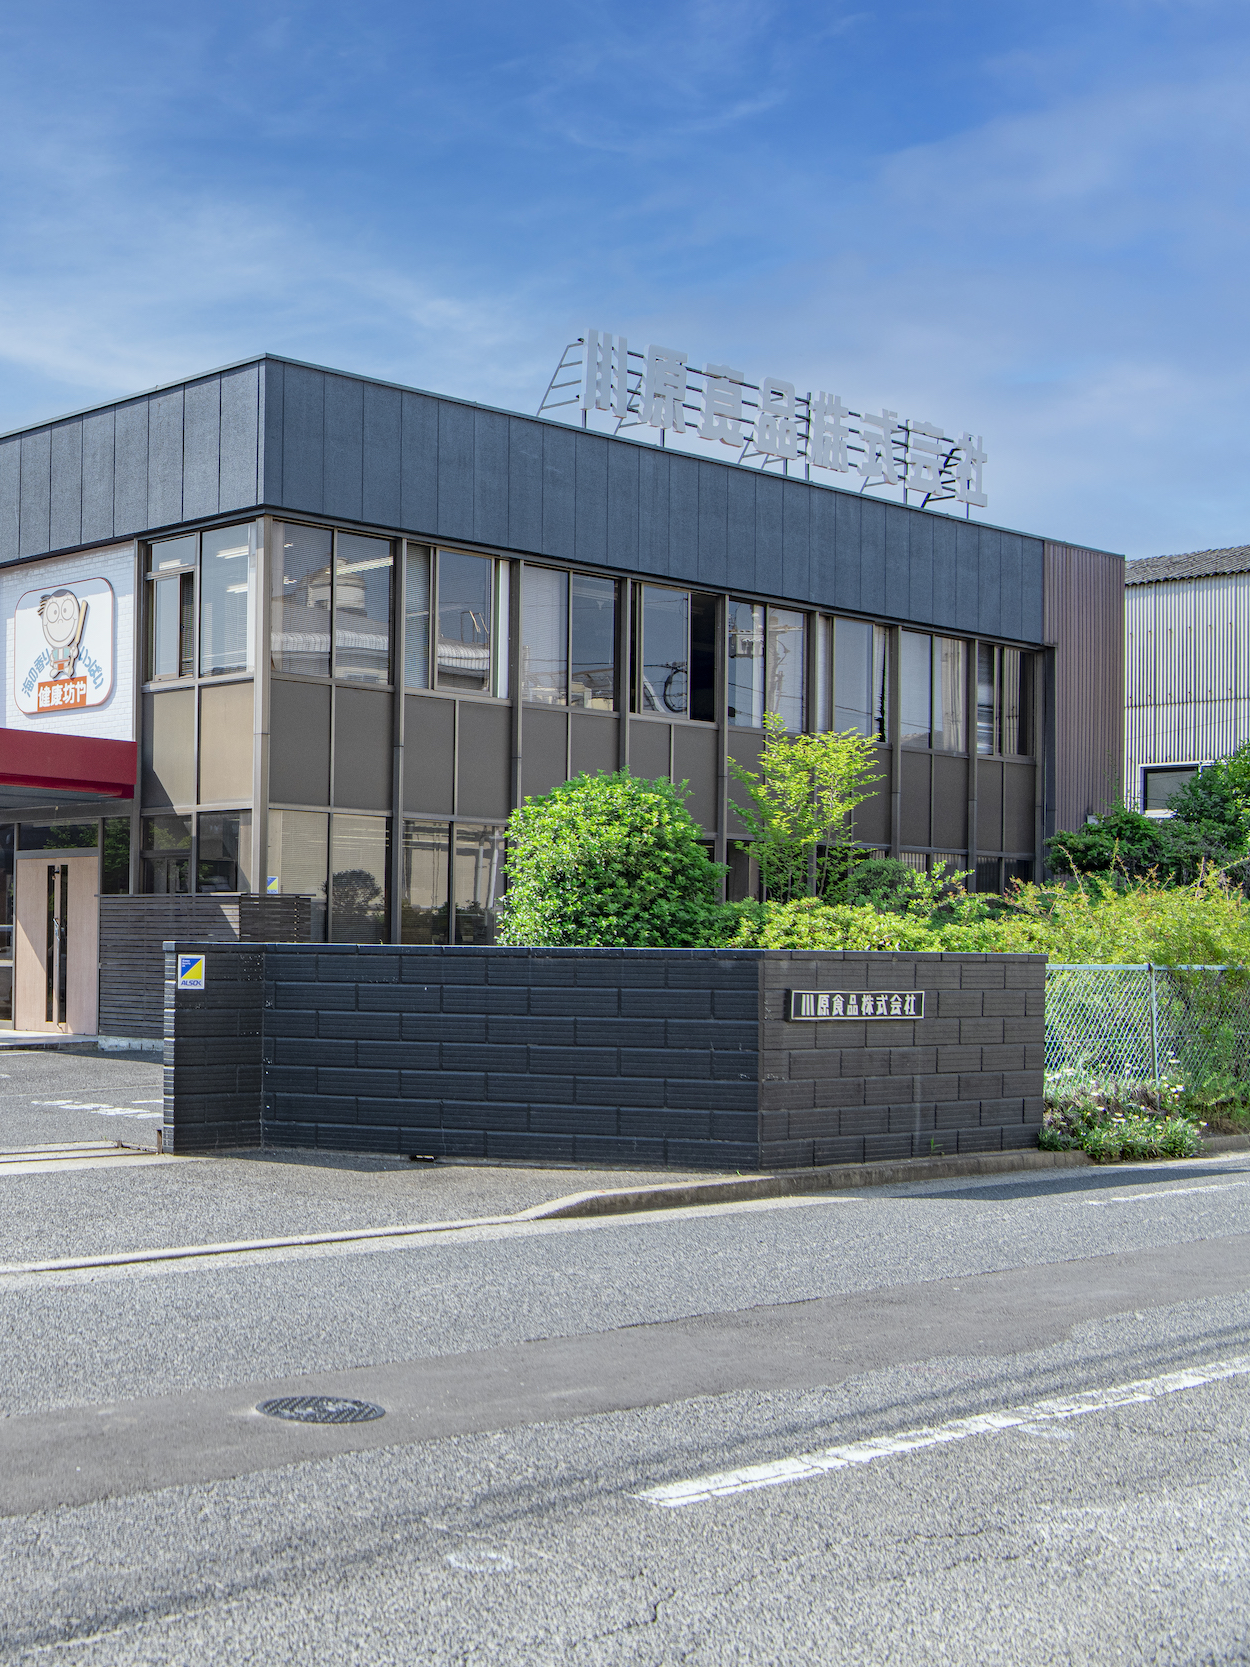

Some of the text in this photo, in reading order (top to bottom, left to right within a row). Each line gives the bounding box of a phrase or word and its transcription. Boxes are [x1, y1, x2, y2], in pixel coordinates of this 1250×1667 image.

[578, 328, 988, 507] 川原食品株式会社
[21, 645, 104, 698] 海の香り いっぱい
[38, 680, 87, 708] 健康坊や
[801, 994, 916, 1016] 川原食品株式会社
